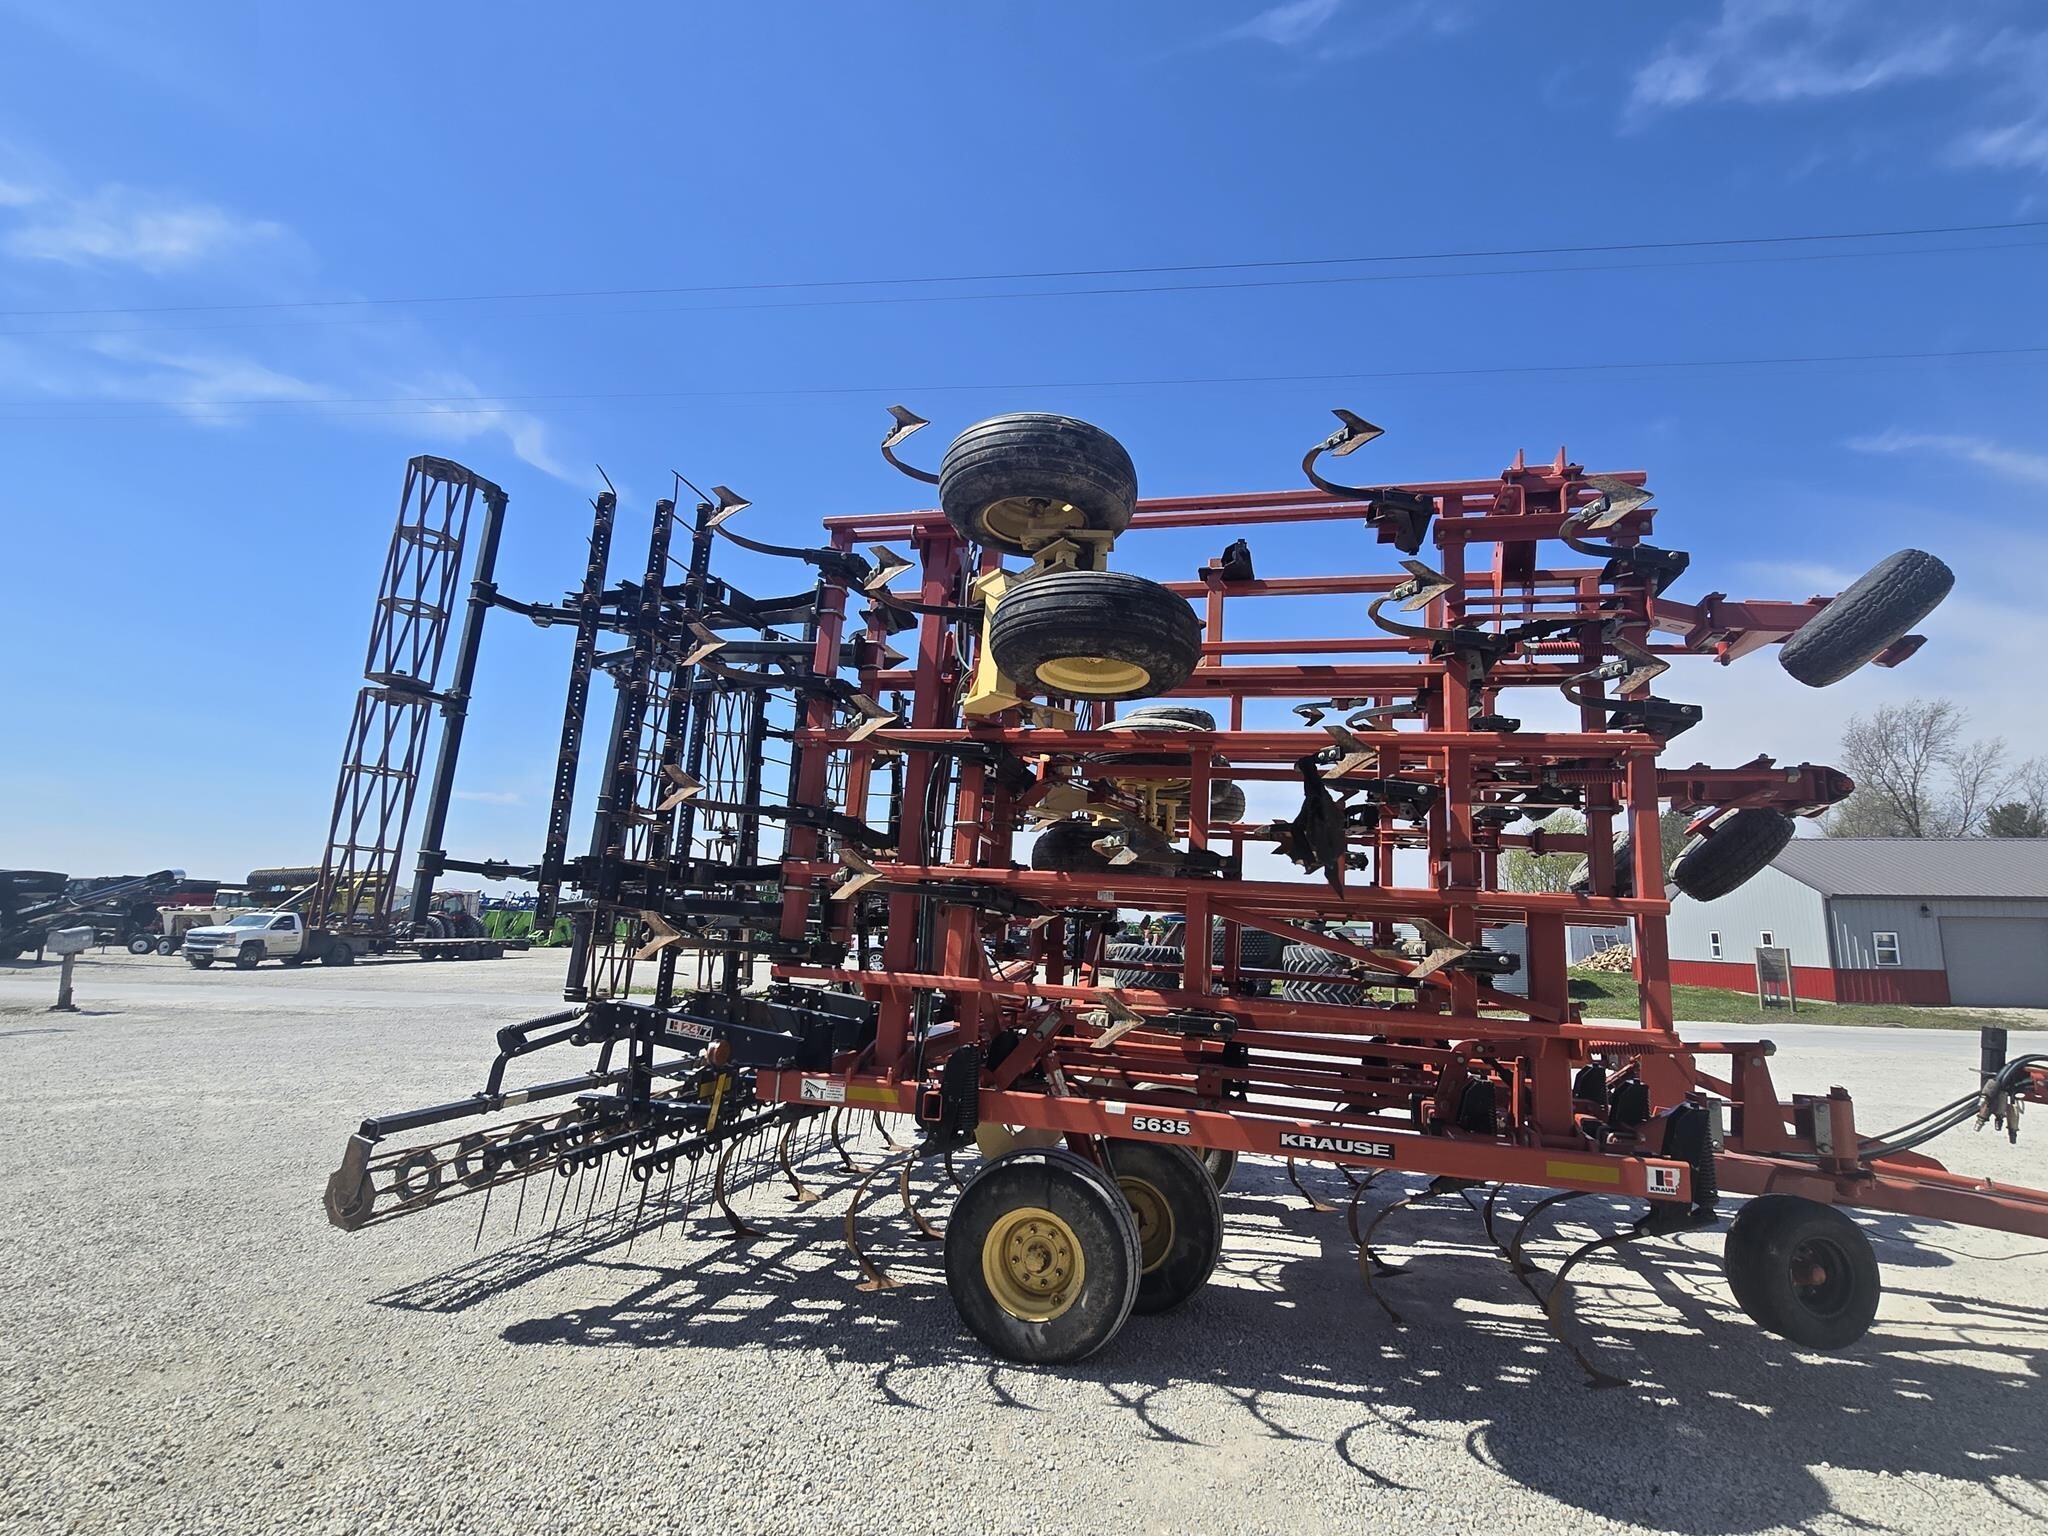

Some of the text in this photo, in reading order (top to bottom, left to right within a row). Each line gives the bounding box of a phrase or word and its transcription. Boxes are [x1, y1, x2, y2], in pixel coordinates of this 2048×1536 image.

[681, 1022, 711, 1037] 24/7
[1132, 1116, 1191, 1135] 5635
[1281, 1133, 1390, 1157] KRAUSE
